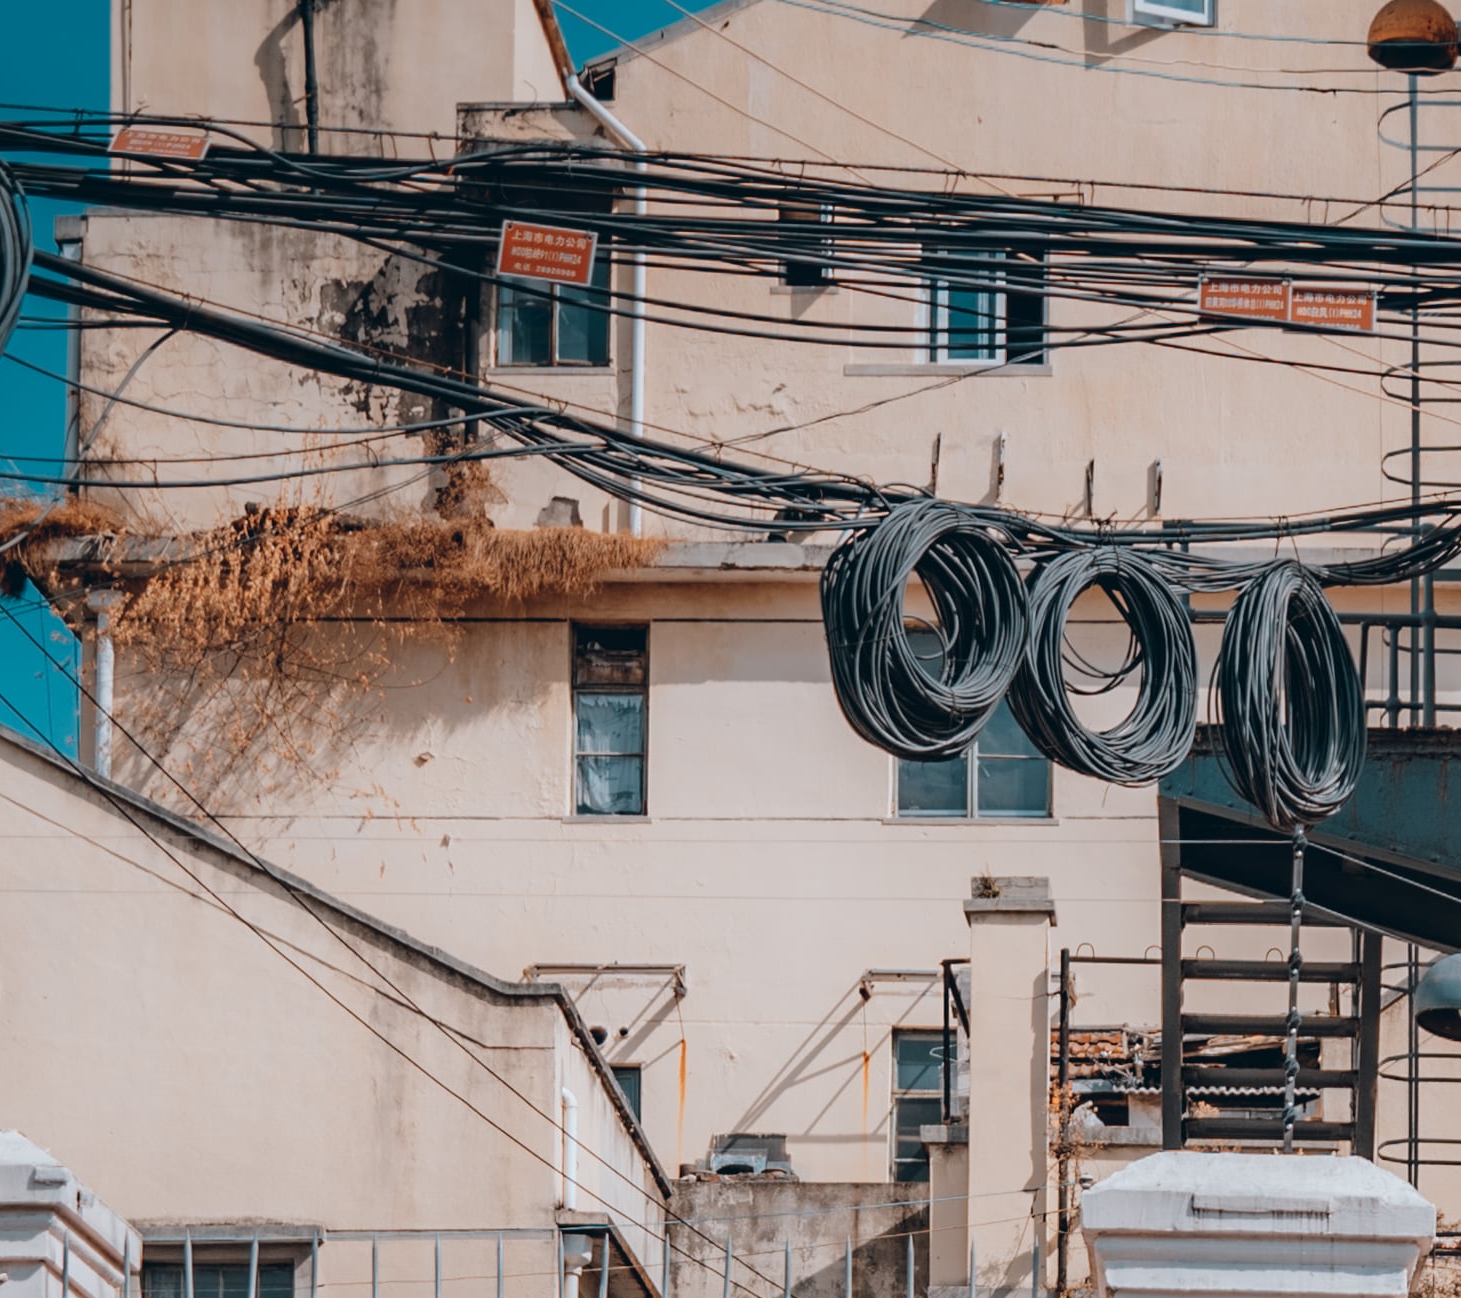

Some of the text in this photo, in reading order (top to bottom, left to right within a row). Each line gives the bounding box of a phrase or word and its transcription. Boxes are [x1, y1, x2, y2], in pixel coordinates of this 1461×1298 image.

[511, 229, 587, 250] 上海市电力公司
[1207, 282, 1283, 295] 上海市电力公司
[1292, 292, 1367, 306] 上海市电力公司
